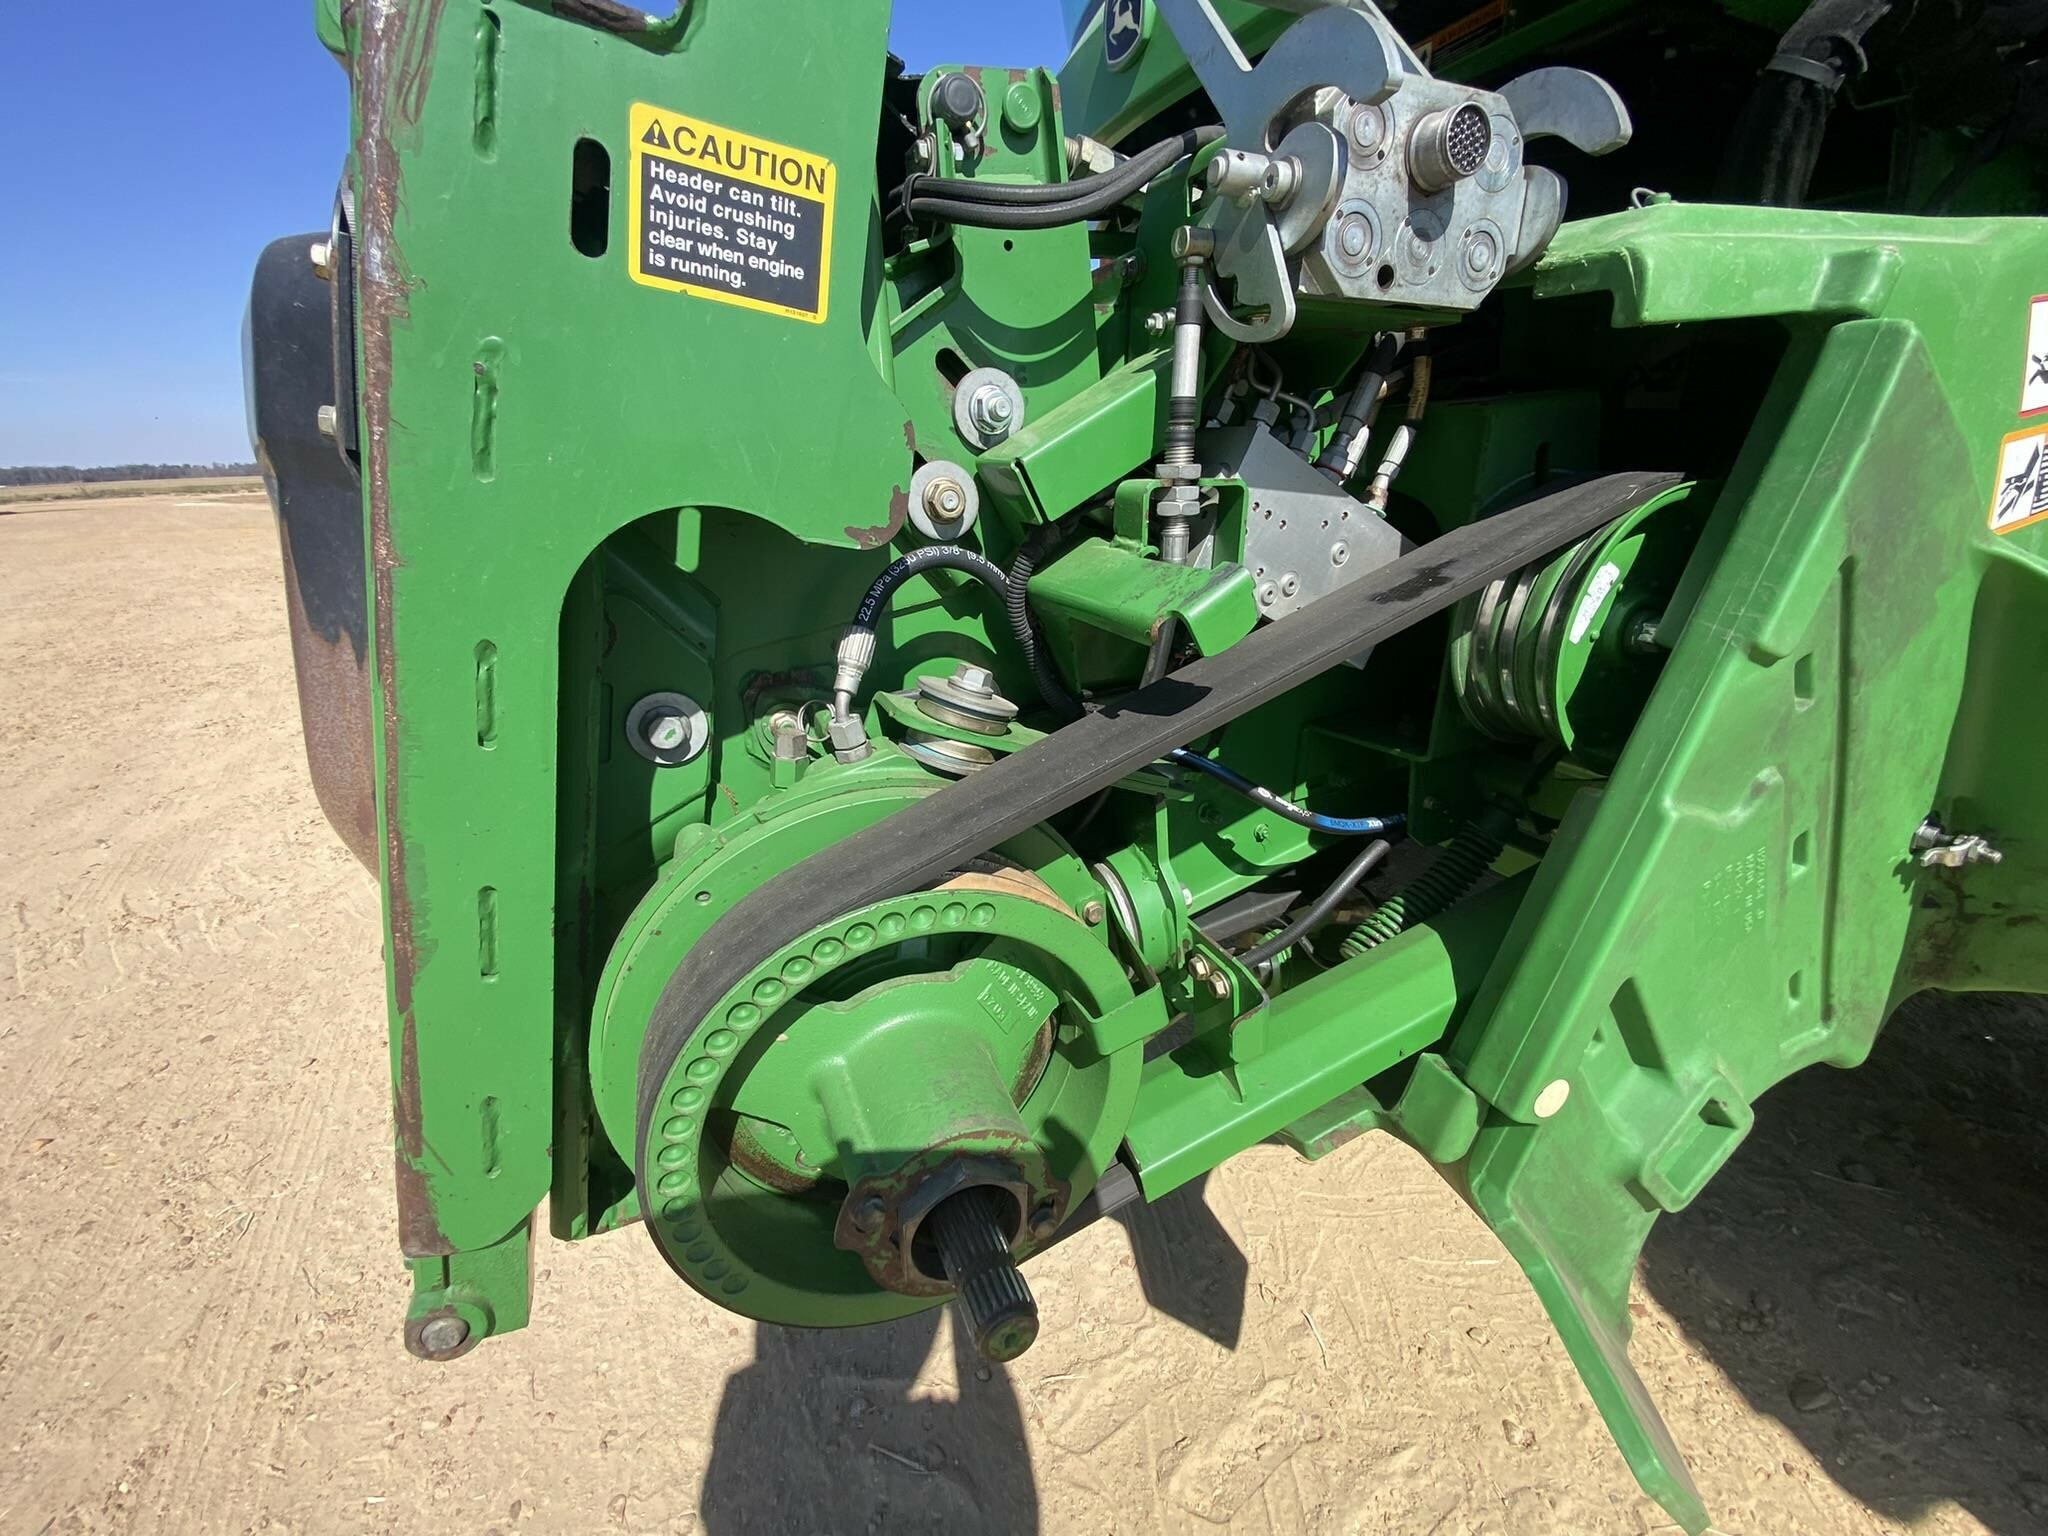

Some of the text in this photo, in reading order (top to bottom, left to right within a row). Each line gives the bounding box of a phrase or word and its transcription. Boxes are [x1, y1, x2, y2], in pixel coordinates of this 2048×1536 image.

[673, 126, 826, 194] CAUTION
[650, 160, 801, 217] Header can tilt.
[650, 183, 795, 240] Avoid crushing
[648, 230, 805, 280] clear when engine
[649, 205, 778, 255] injuries. Stay
[649, 249, 747, 289] is running.
[858, 597, 876, 622] 22.5
[870, 574, 892, 600] MPa
